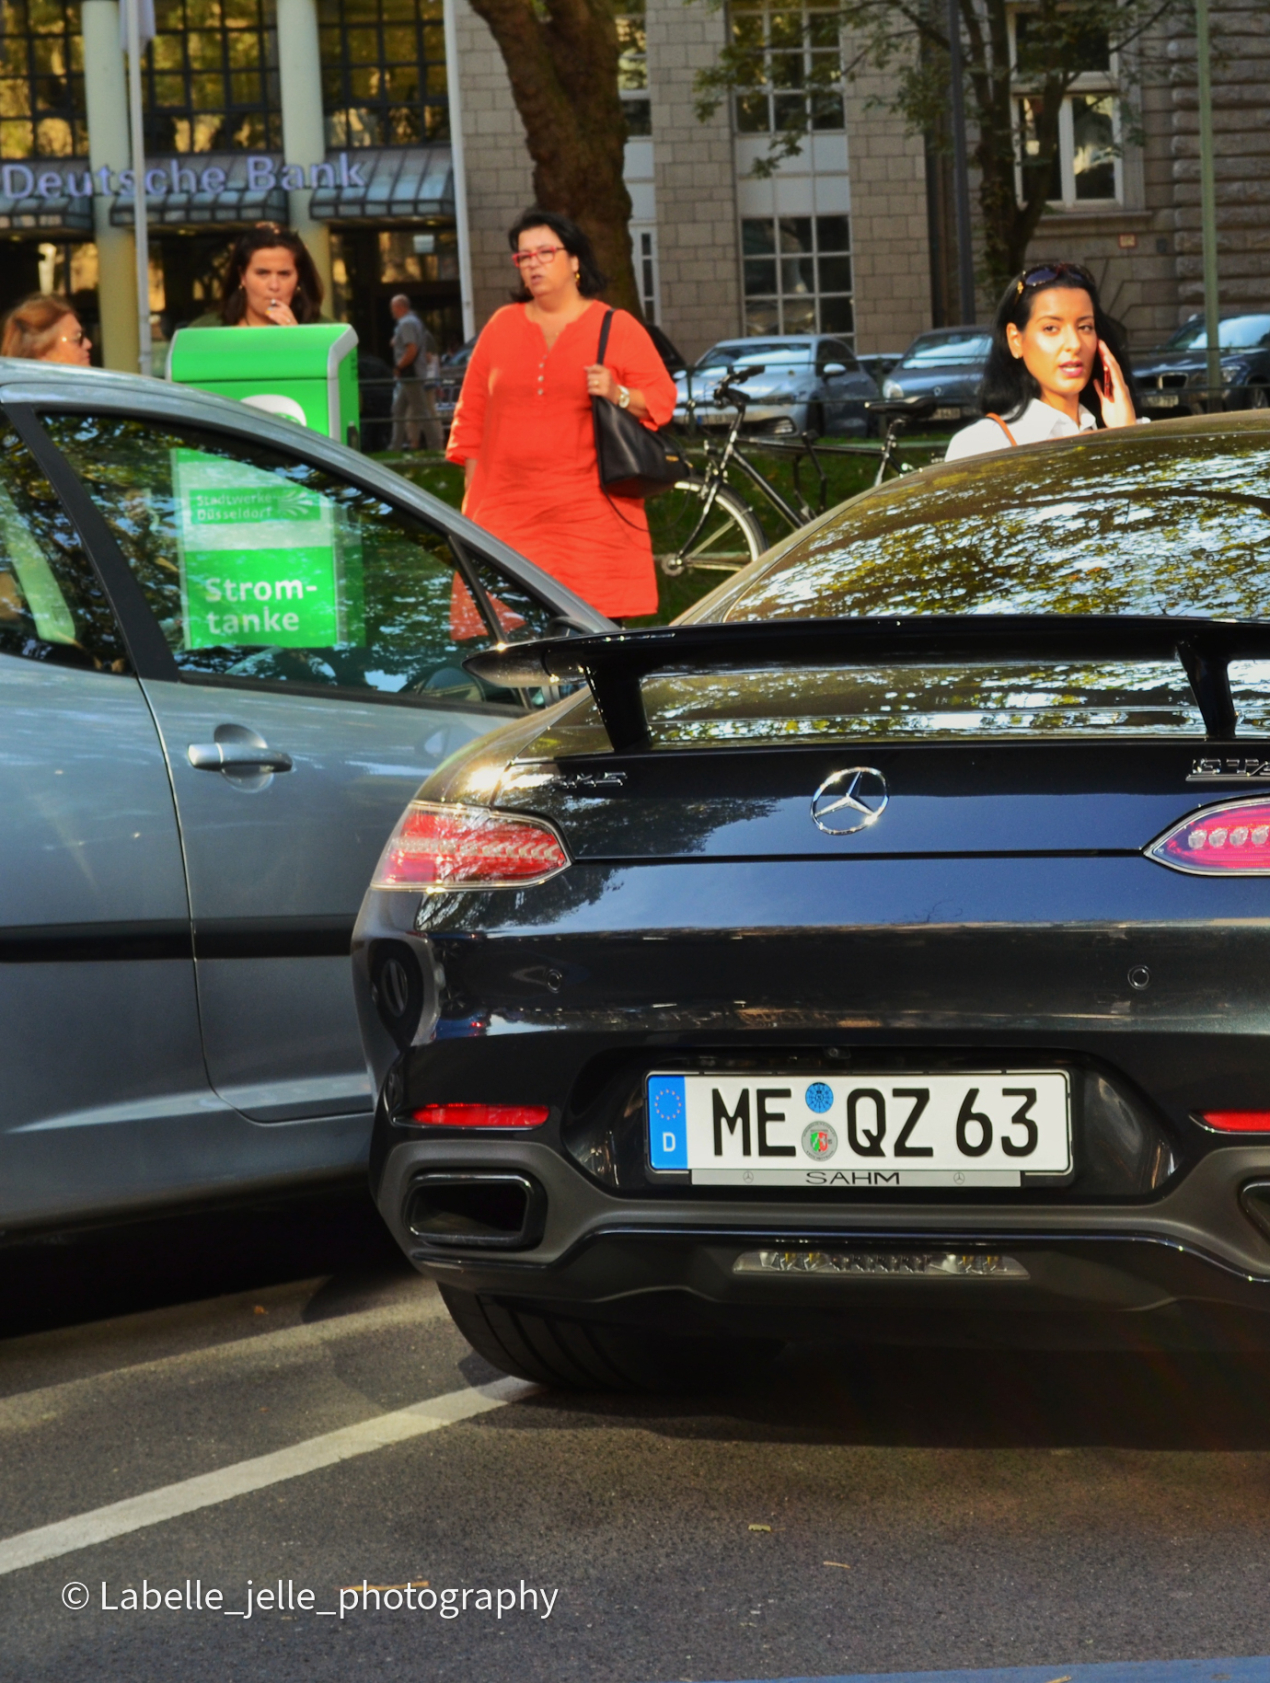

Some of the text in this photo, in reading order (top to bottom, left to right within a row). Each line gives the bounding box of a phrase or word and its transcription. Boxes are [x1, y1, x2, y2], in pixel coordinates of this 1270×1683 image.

[1, 152, 367, 200] Deutsche Bank
[196, 491, 273, 507] Stadtwerke
[196, 505, 274, 521] Düsseldorf
[205, 577, 318, 603] Strom-
[206, 605, 300, 635] tanke
[711, 1088, 797, 1157] ME
[846, 1088, 934, 1157] QZ
[955, 1088, 1038, 1157] 63
[662, 1132, 676, 1152] D
[805, 1171, 900, 1186] SAHM
